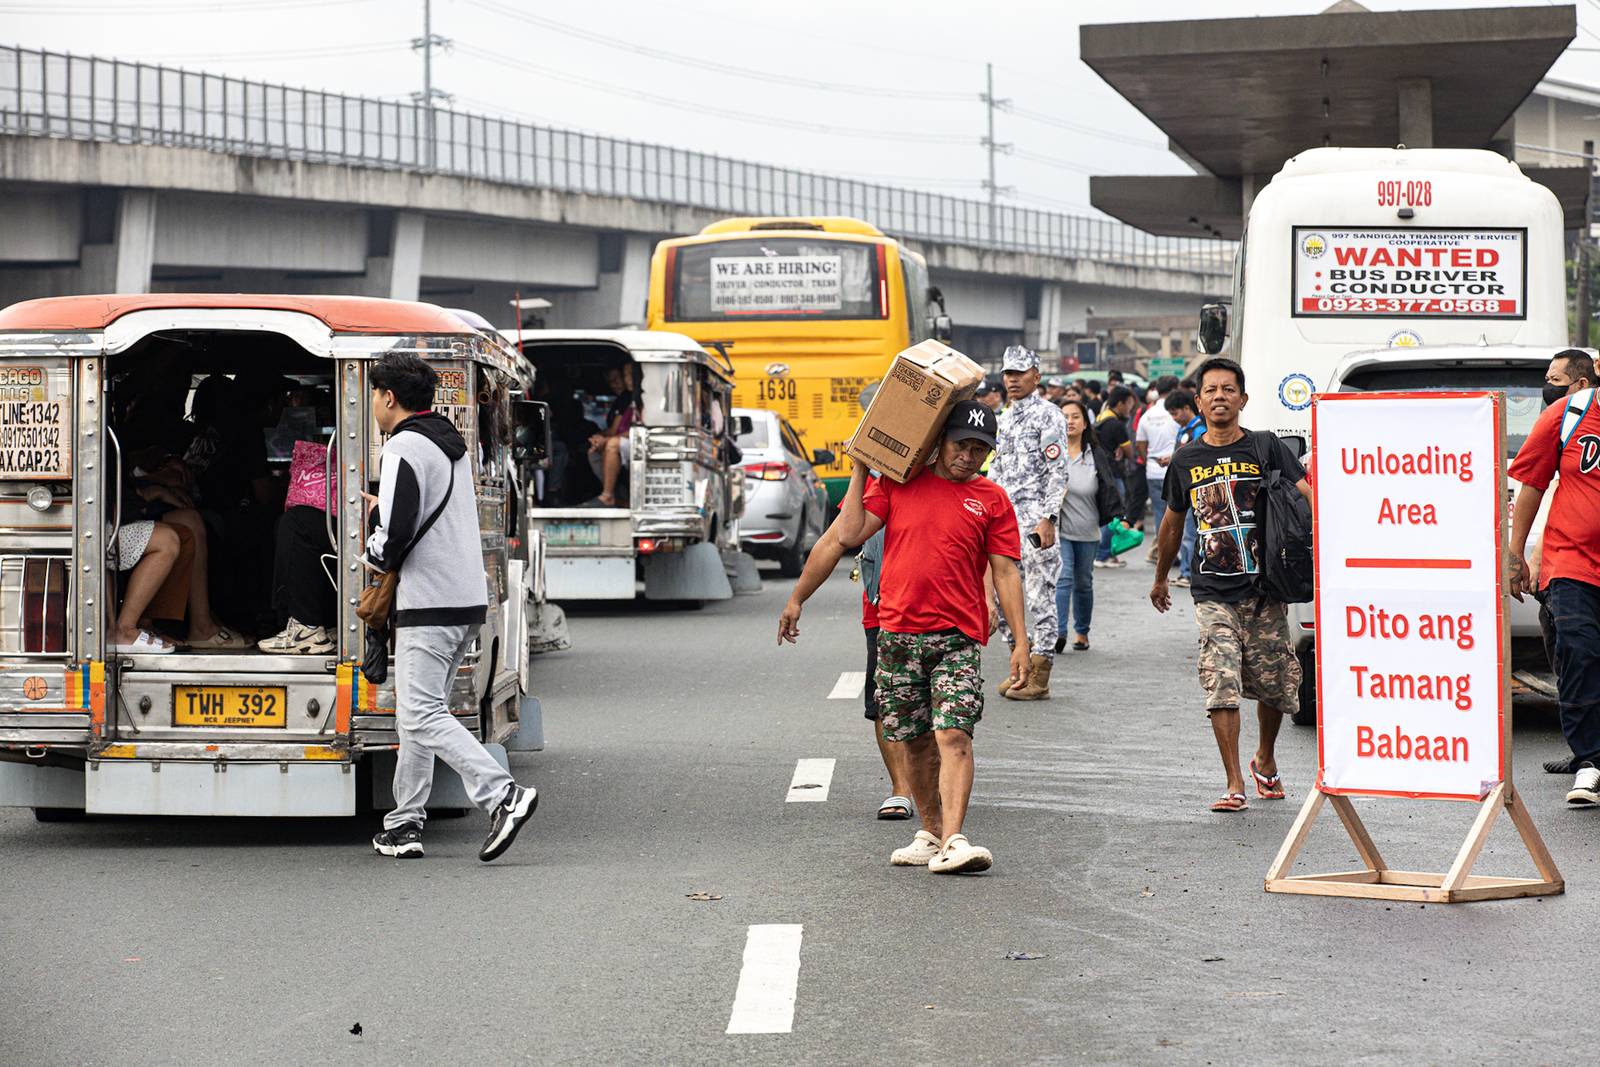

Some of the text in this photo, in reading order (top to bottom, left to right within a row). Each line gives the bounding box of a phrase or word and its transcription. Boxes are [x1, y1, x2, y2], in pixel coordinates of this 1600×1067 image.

[1378, 181, 1432, 207] 997-028
[717, 262, 836, 275] WE ARE HIRING!
[1334, 247, 1500, 268] WANTED
[1330, 270, 1497, 282] BUS DRIVER
[1330, 283, 1504, 295] CONDUCTOR
[1318, 299, 1500, 313] 0923-377-0568
[1341, 446, 1473, 482] Unloading
[1577, 434, 1600, 474] D
[1190, 462, 1260, 484] BEATLES
[1378, 498, 1437, 525] Area
[1346, 604, 1474, 650] Dito ang
[1350, 666, 1473, 711] Tamang
[186, 693, 276, 716] TWH 392
[1356, 725, 1469, 762] Babaan
